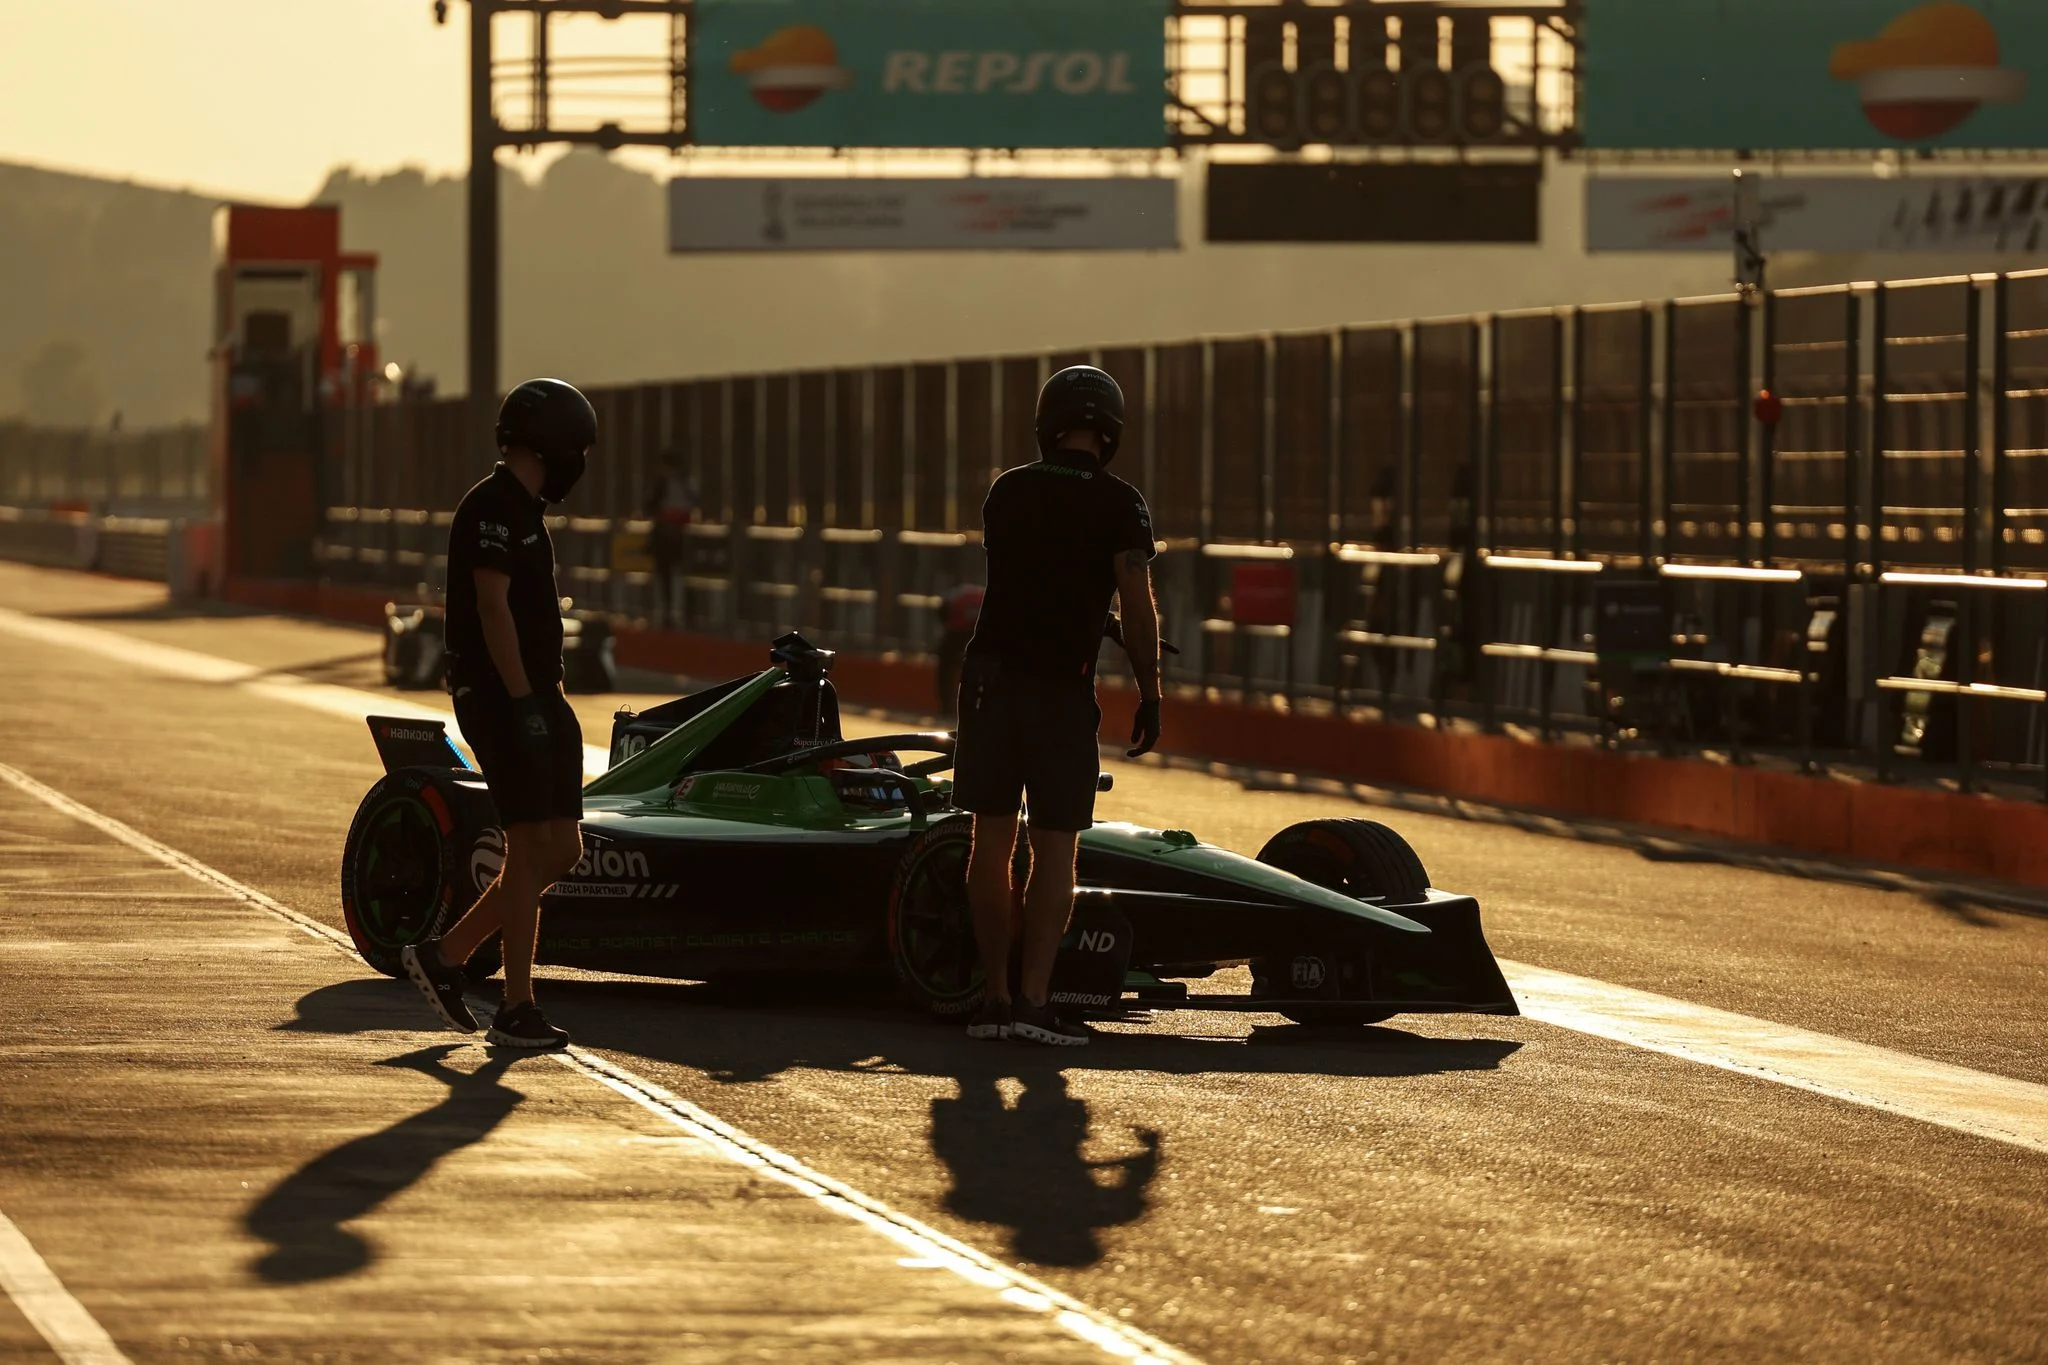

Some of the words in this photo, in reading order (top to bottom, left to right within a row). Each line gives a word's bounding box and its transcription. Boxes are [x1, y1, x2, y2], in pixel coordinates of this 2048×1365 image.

[883, 51, 1137, 94] REPSOL
[574, 839, 651, 878] sion
[558, 883, 581, 894] TECH
[582, 884, 628, 896] PARTNER
[599, 935, 677, 949] AGAINST
[687, 933, 772, 948] CLIMATE
[780, 930, 857, 945] CHANGE
[1077, 929, 1116, 953] ND
[1292, 961, 1321, 984] FIA
